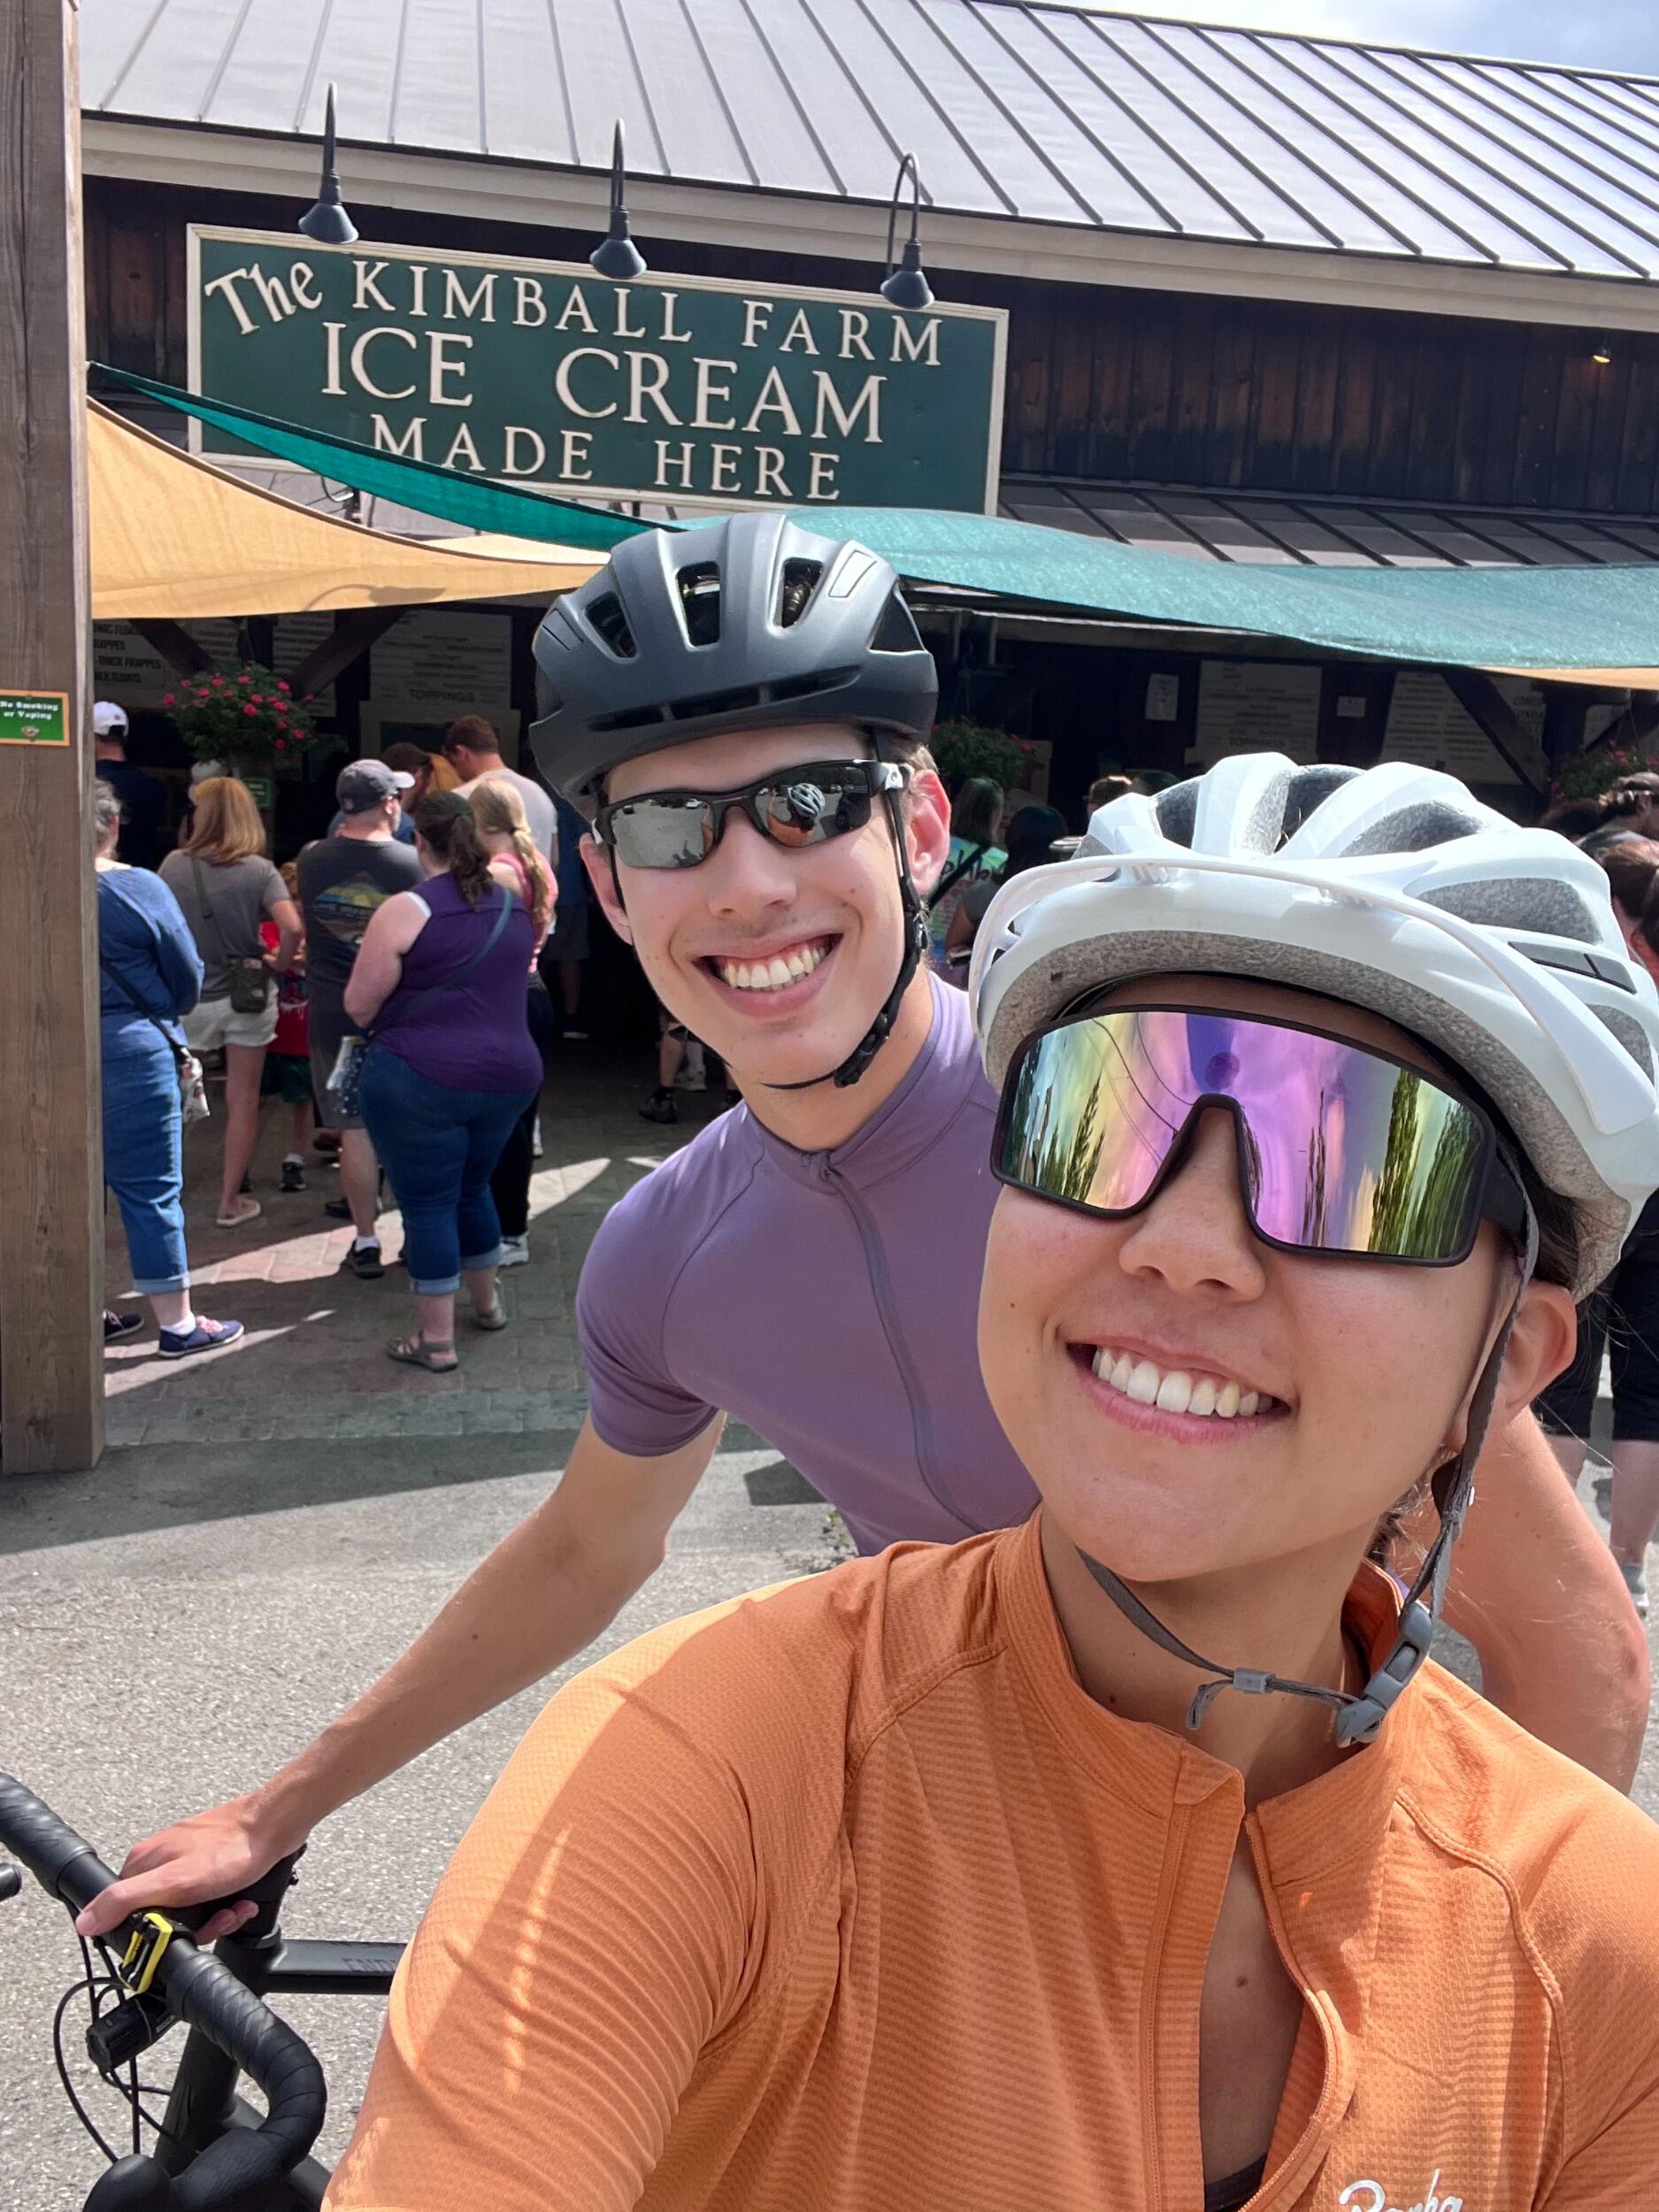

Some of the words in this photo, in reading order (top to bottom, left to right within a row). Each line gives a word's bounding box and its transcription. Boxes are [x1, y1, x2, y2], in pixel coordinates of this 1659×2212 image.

[204, 259, 322, 336] The
[352, 259, 694, 343] KIMBALL
[741, 298, 943, 366] FARM
[321, 322, 474, 407] ICE
[555, 347, 887, 443] CREAM
[370, 413, 593, 480] MADE
[654, 440, 841, 501] HERE
[16, 701, 59, 711] Smoking
[18, 710, 52, 721] Vaping
[409, 689, 475, 703] TOPPINGS
